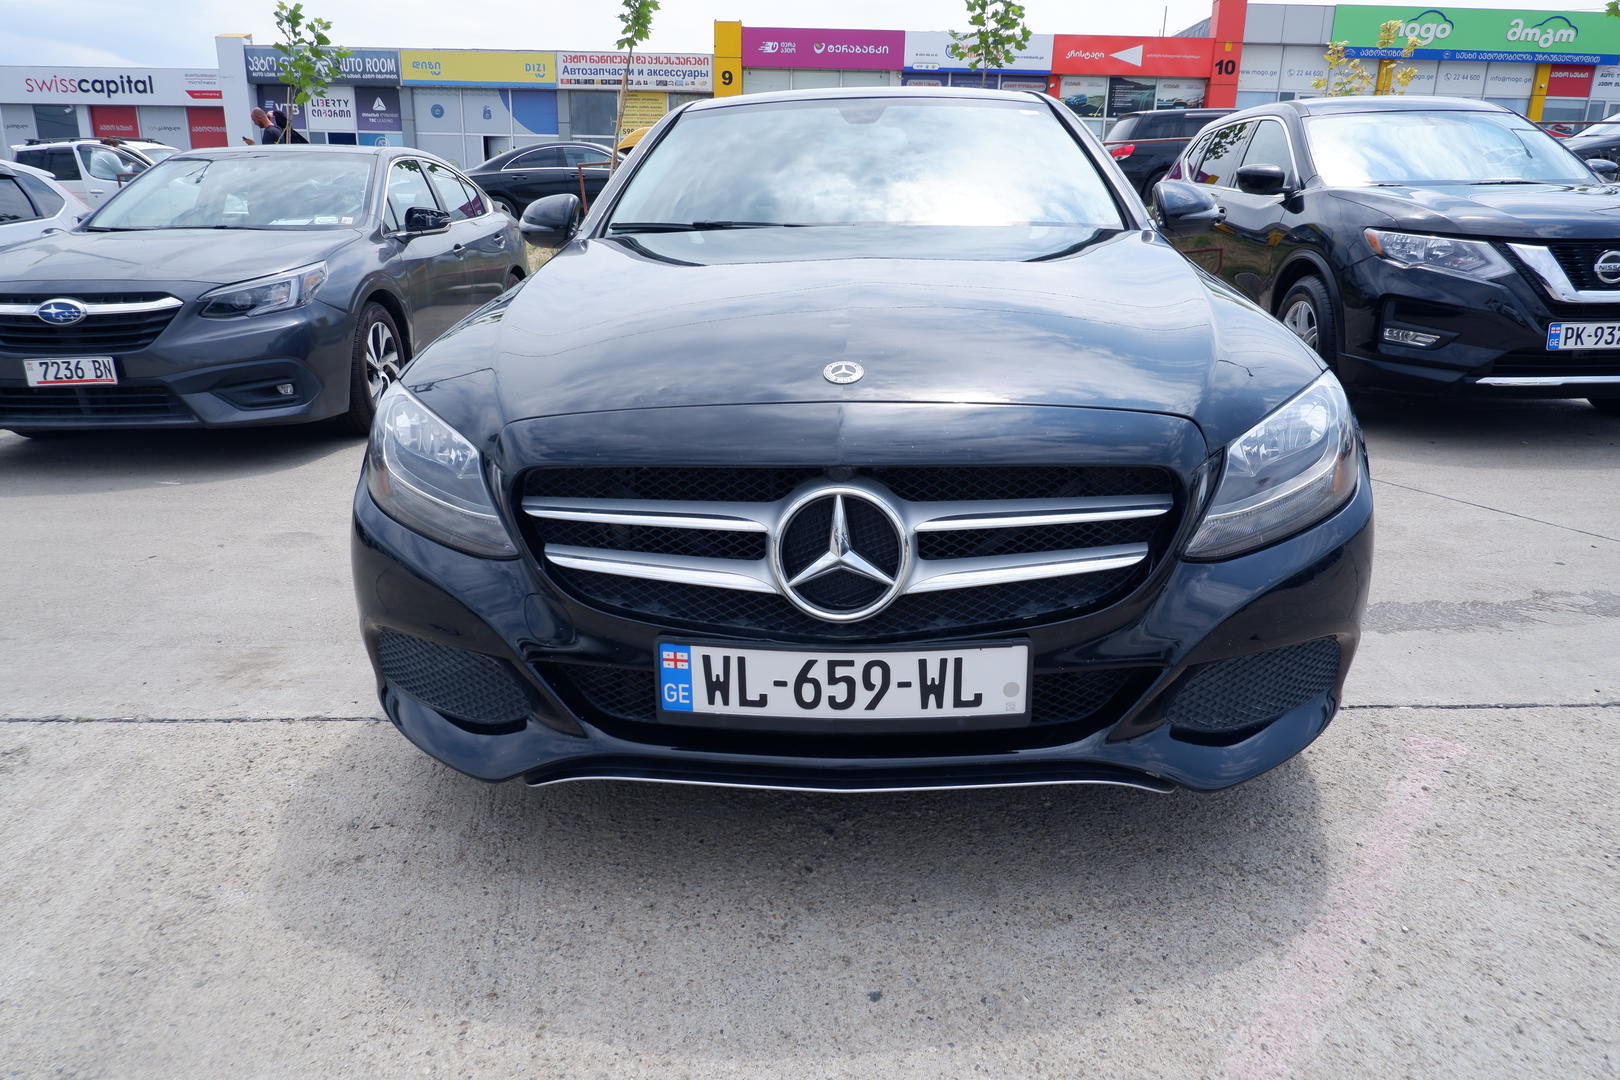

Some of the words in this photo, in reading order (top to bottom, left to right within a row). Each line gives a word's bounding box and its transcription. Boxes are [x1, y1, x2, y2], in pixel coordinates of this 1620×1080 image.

[1506, 18, 1576, 48] მოგო
[827, 44, 889, 54] ტერაბანკი
[1065, 50, 1105, 60] კრისტალი
[247, 56, 276, 71] ავტო
[365, 58, 396, 72] ROOM
[562, 54, 588, 64] ავტო
[636, 56, 646, 64] და
[647, 56, 709, 66] აქსესუარები
[525, 63, 545, 72] DIZI
[562, 65, 634, 76] Автозапчасти
[647, 68, 709, 79] аксессуары
[1215, 60, 1236, 75] 10
[721, 70, 734, 86] 9
[25, 75, 154, 98] swisscapital
[275, 103, 300, 115] VTB
[311, 98, 349, 107] LIBERTY
[311, 109, 352, 118] ლიბერთი
[1549, 338, 1559, 346] GE
[39, 361, 85, 380] 7236
[92, 359, 113, 379] BN
[702, 654, 983, 711] WL-659-WL
[664, 683, 690, 704] GE
